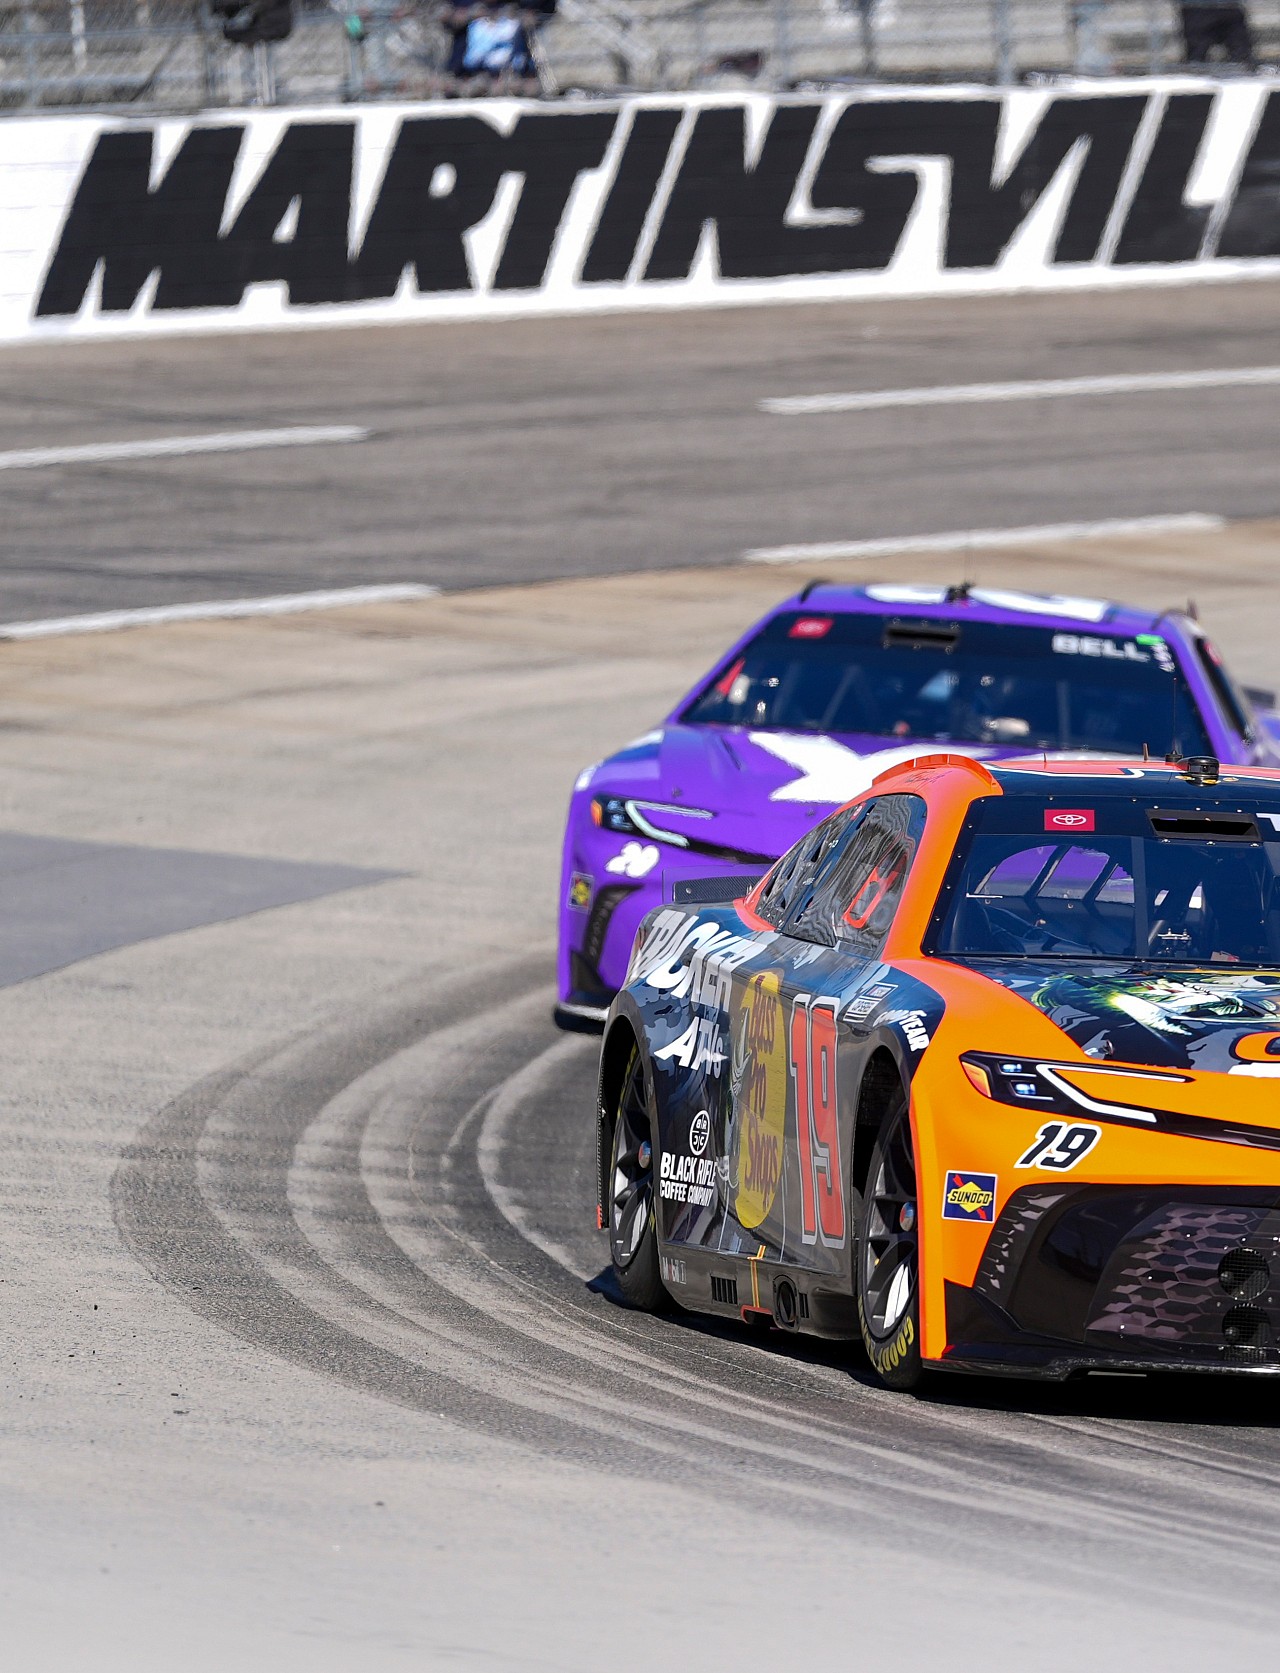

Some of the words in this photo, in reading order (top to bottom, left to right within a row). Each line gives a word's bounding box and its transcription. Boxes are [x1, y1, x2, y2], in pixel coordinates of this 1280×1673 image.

[1052, 633, 1150, 663] BELL
[631, 909, 768, 1012] TRACKER
[789, 993, 846, 1249] 19
[1016, 1123, 1099, 1170] 19
[660, 1151, 695, 1184] BLACK
[696, 1157, 717, 1187] RIFLE
[659, 1179, 687, 1202] COFFEE
[688, 1184, 713, 1207] COMPANY
[949, 1190, 990, 1205] SUNOCO
